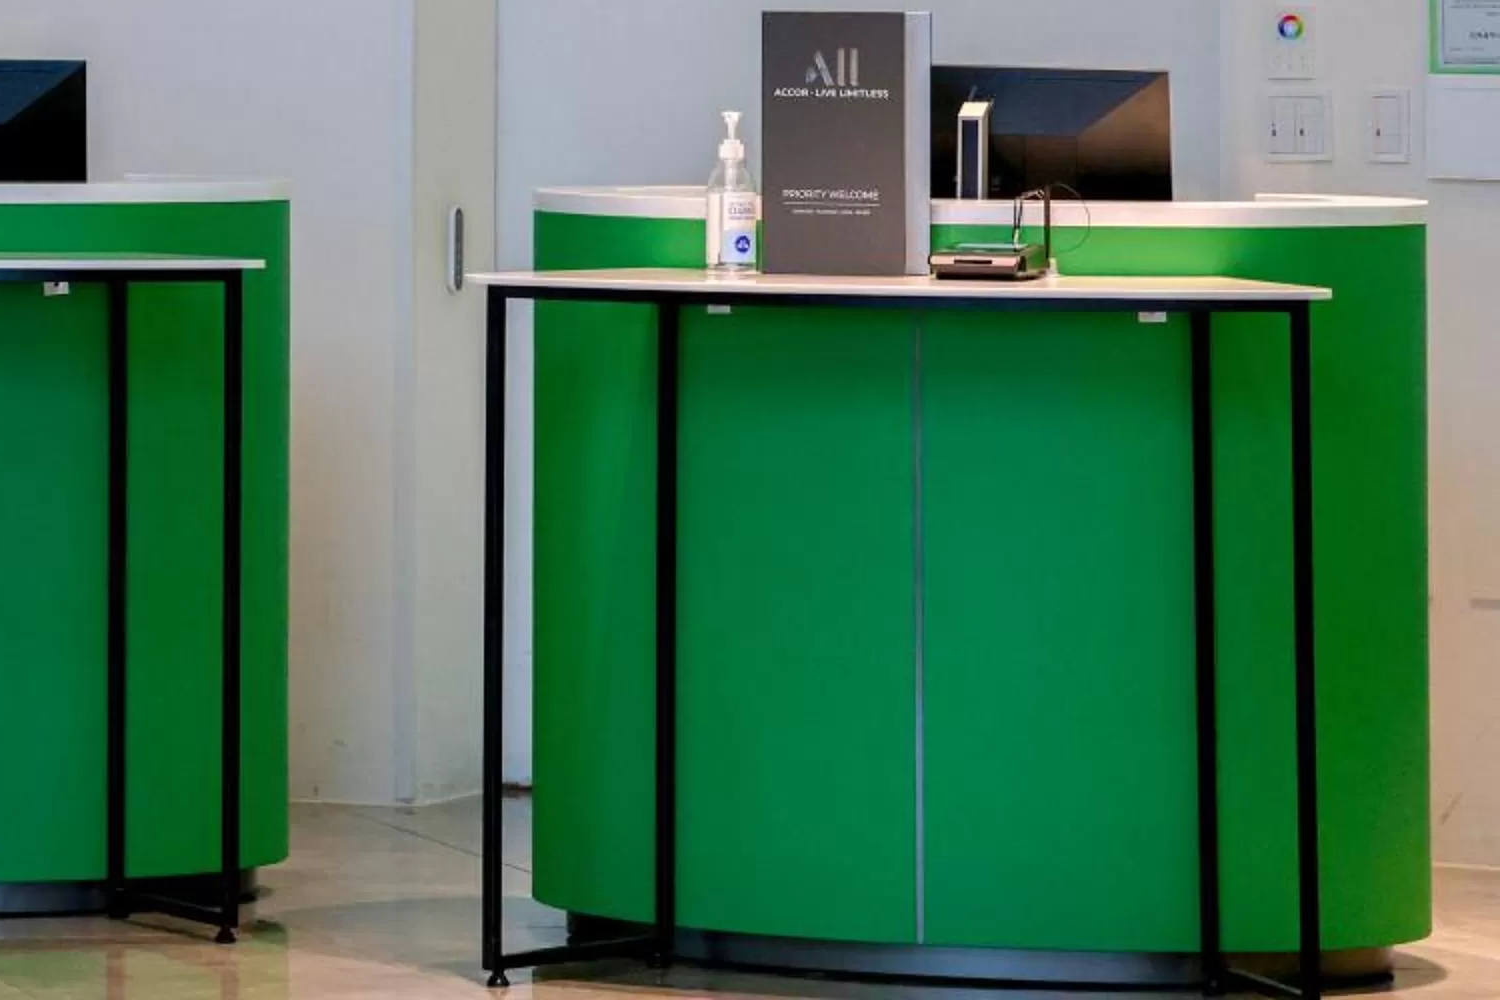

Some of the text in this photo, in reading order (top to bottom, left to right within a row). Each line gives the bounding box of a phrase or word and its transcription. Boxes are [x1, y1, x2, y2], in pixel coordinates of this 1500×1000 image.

[773, 87, 890, 100] ACCOR LIVE LIMITLESS
[782, 188, 880, 201] PRIORITY WELCOME
